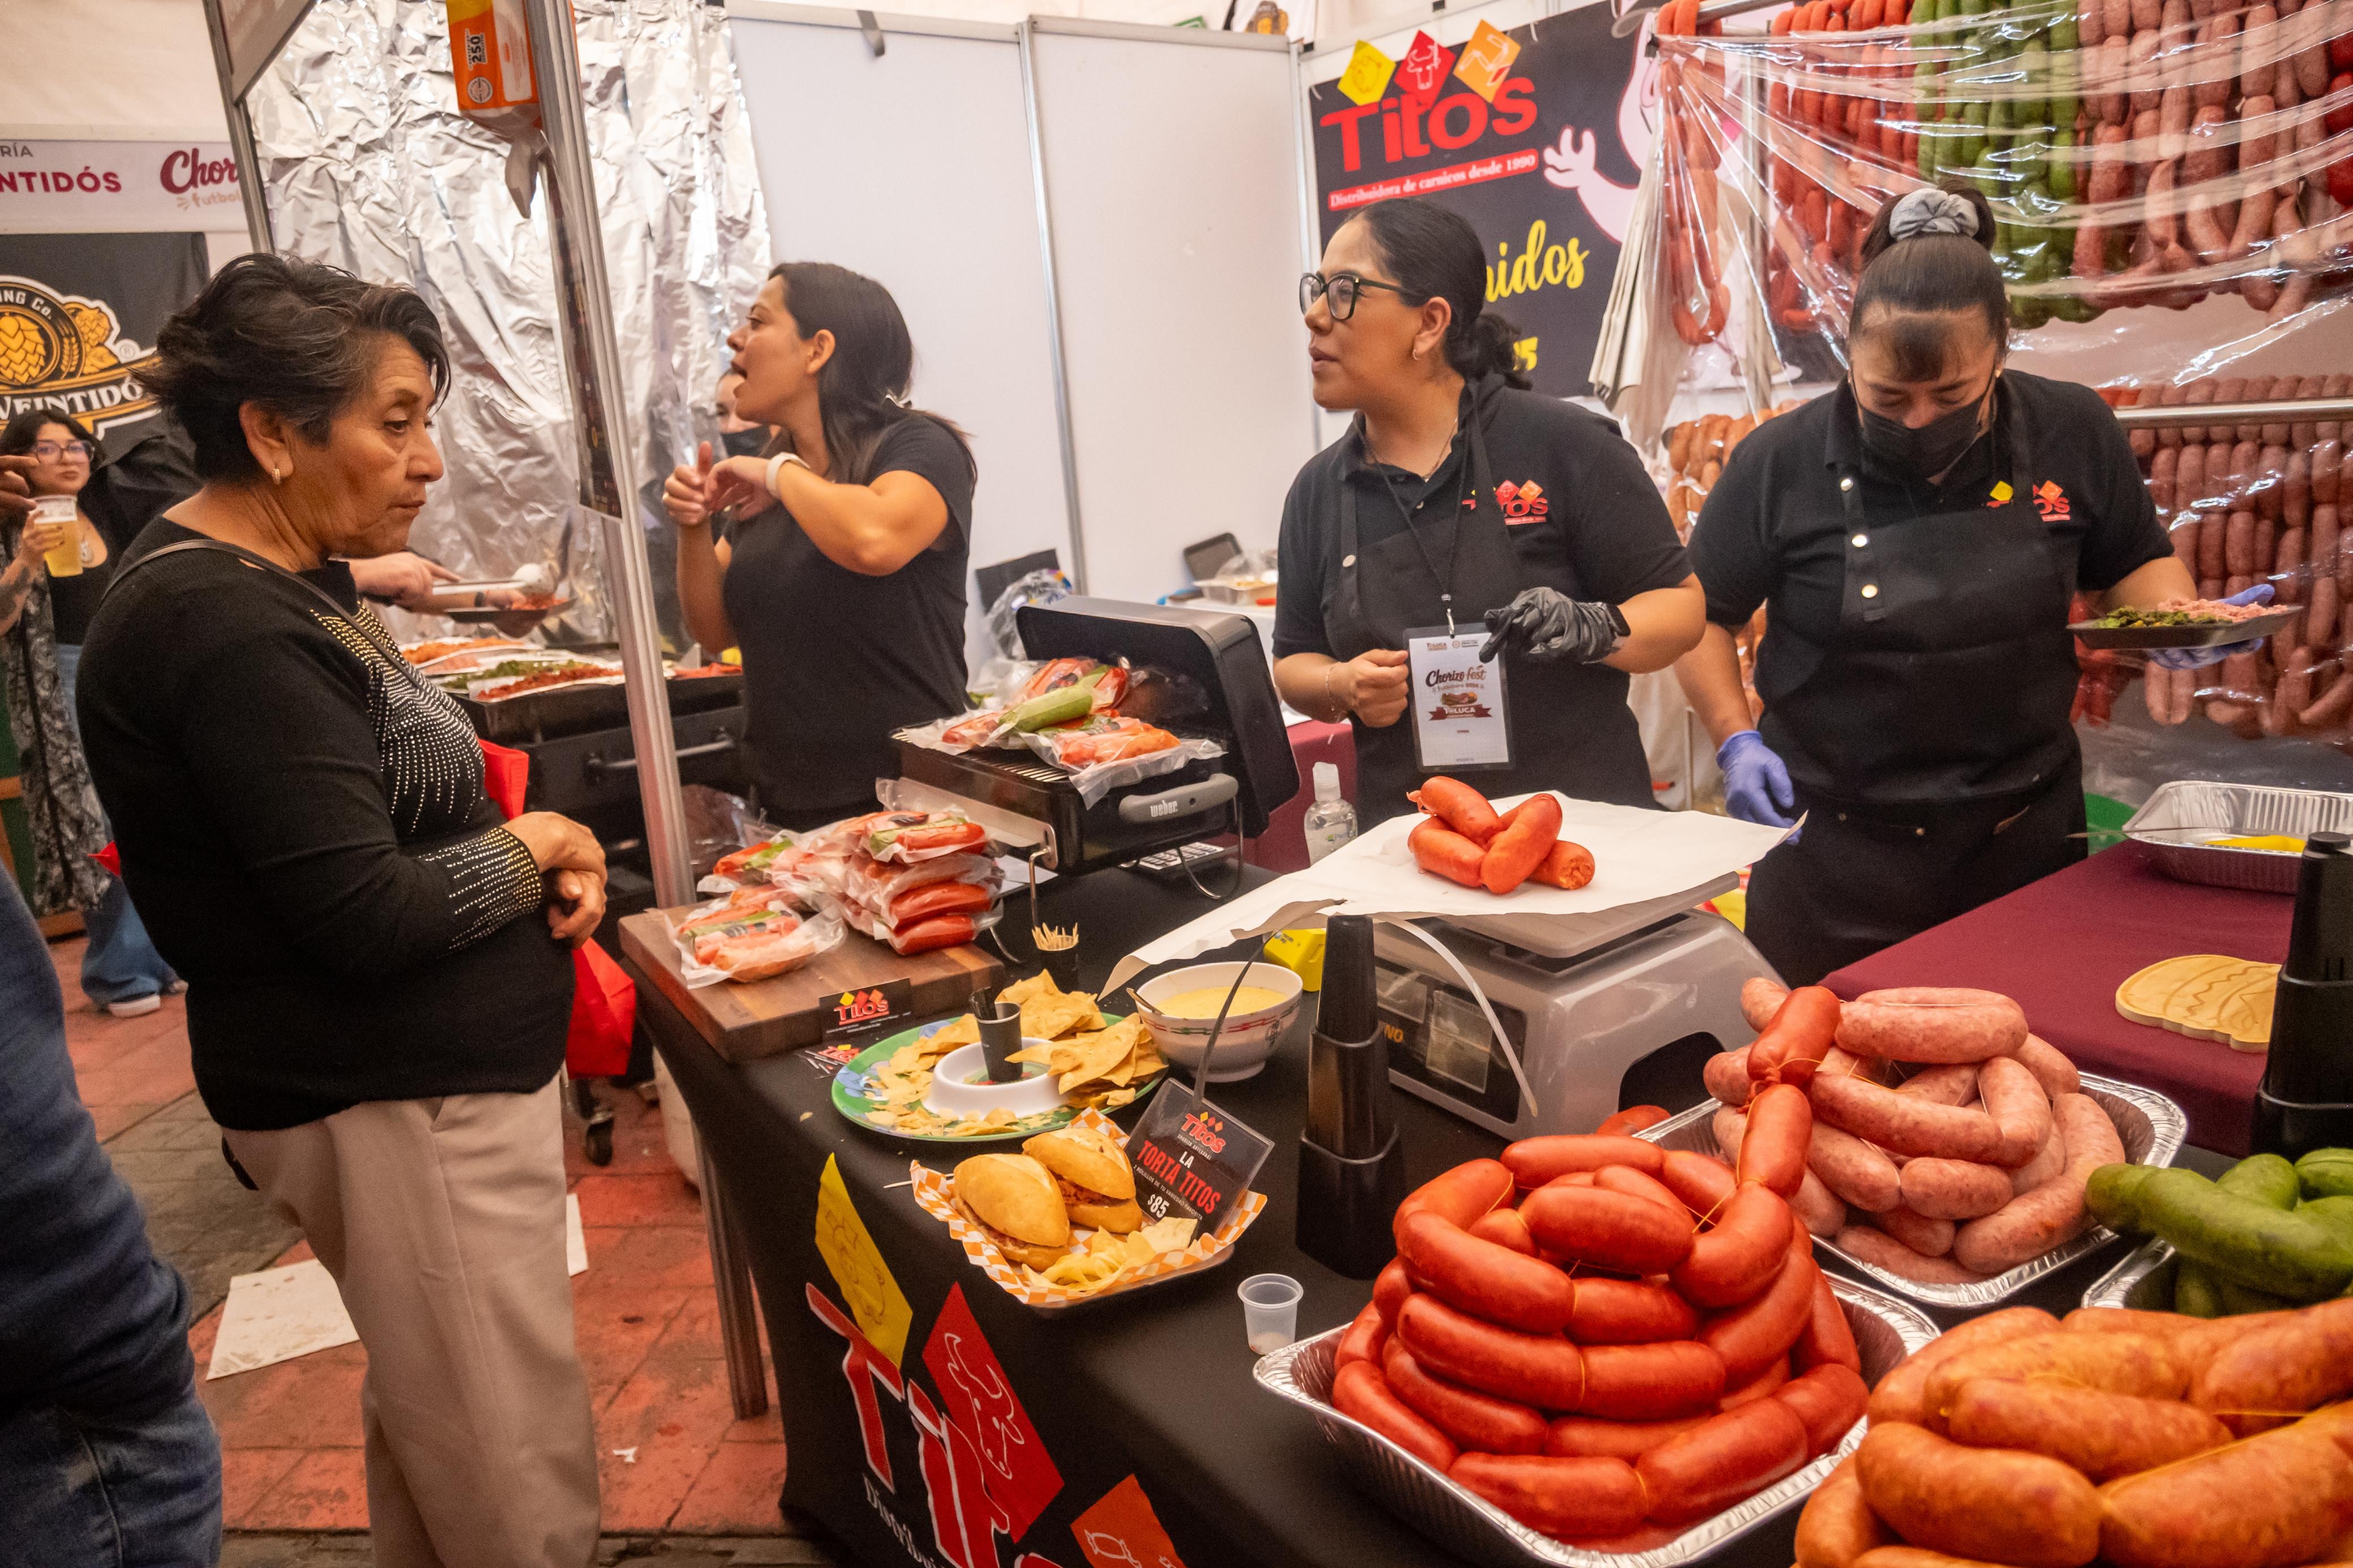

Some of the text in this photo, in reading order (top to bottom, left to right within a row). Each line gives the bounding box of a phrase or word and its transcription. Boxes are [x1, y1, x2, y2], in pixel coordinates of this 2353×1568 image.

[470, 35, 482, 64] 250
[1330, 185, 1401, 208] Distribuidora
[1403, 179, 1417, 193] de
[1468, 161, 1502, 179] desde
[1506, 154, 1536, 171] 1990
[1426, 669, 1464, 687] Chorizo
[1179, 1151, 1194, 1168] LA
[1136, 1140, 1221, 1214] TORTA TITOS
[1136, 1167, 1154, 1183] BOLILLOS
[1165, 1189, 1185, 1207] VARIEDAD
[1184, 1204, 1203, 1221] FAVORITA
[1148, 1194, 1170, 1218] $85
